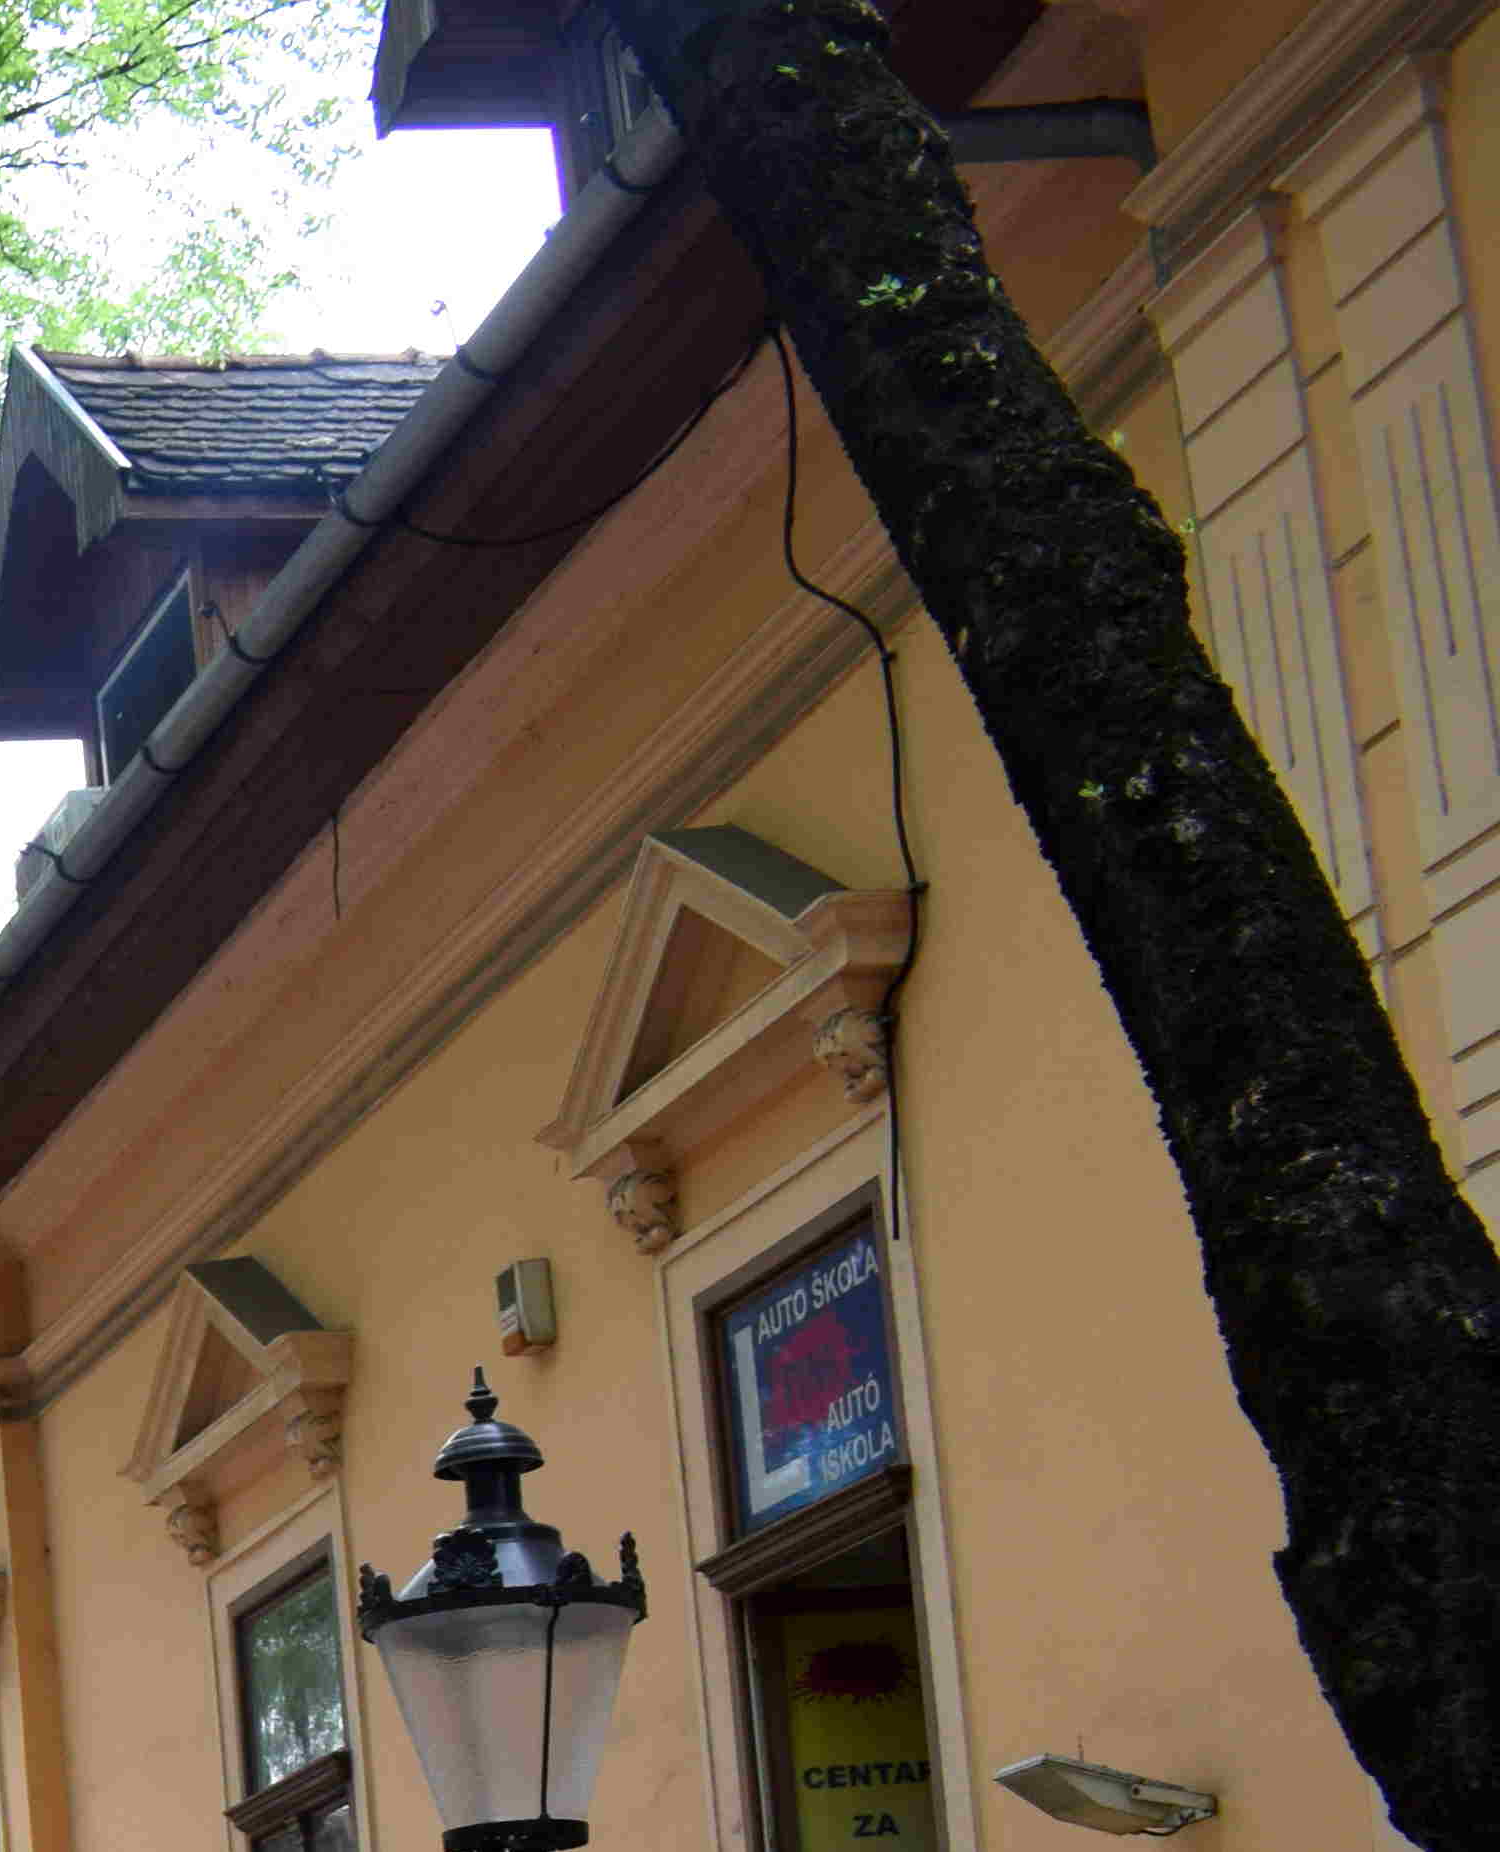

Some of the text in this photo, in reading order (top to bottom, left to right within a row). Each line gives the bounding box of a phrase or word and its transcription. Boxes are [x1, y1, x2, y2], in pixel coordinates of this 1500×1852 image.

[758, 1289, 808, 1344] AUTO
[828, 1371, 880, 1434] AUTÓ
[821, 1421, 894, 1480] ISKOLA
[852, 1813, 900, 1838] ZA
